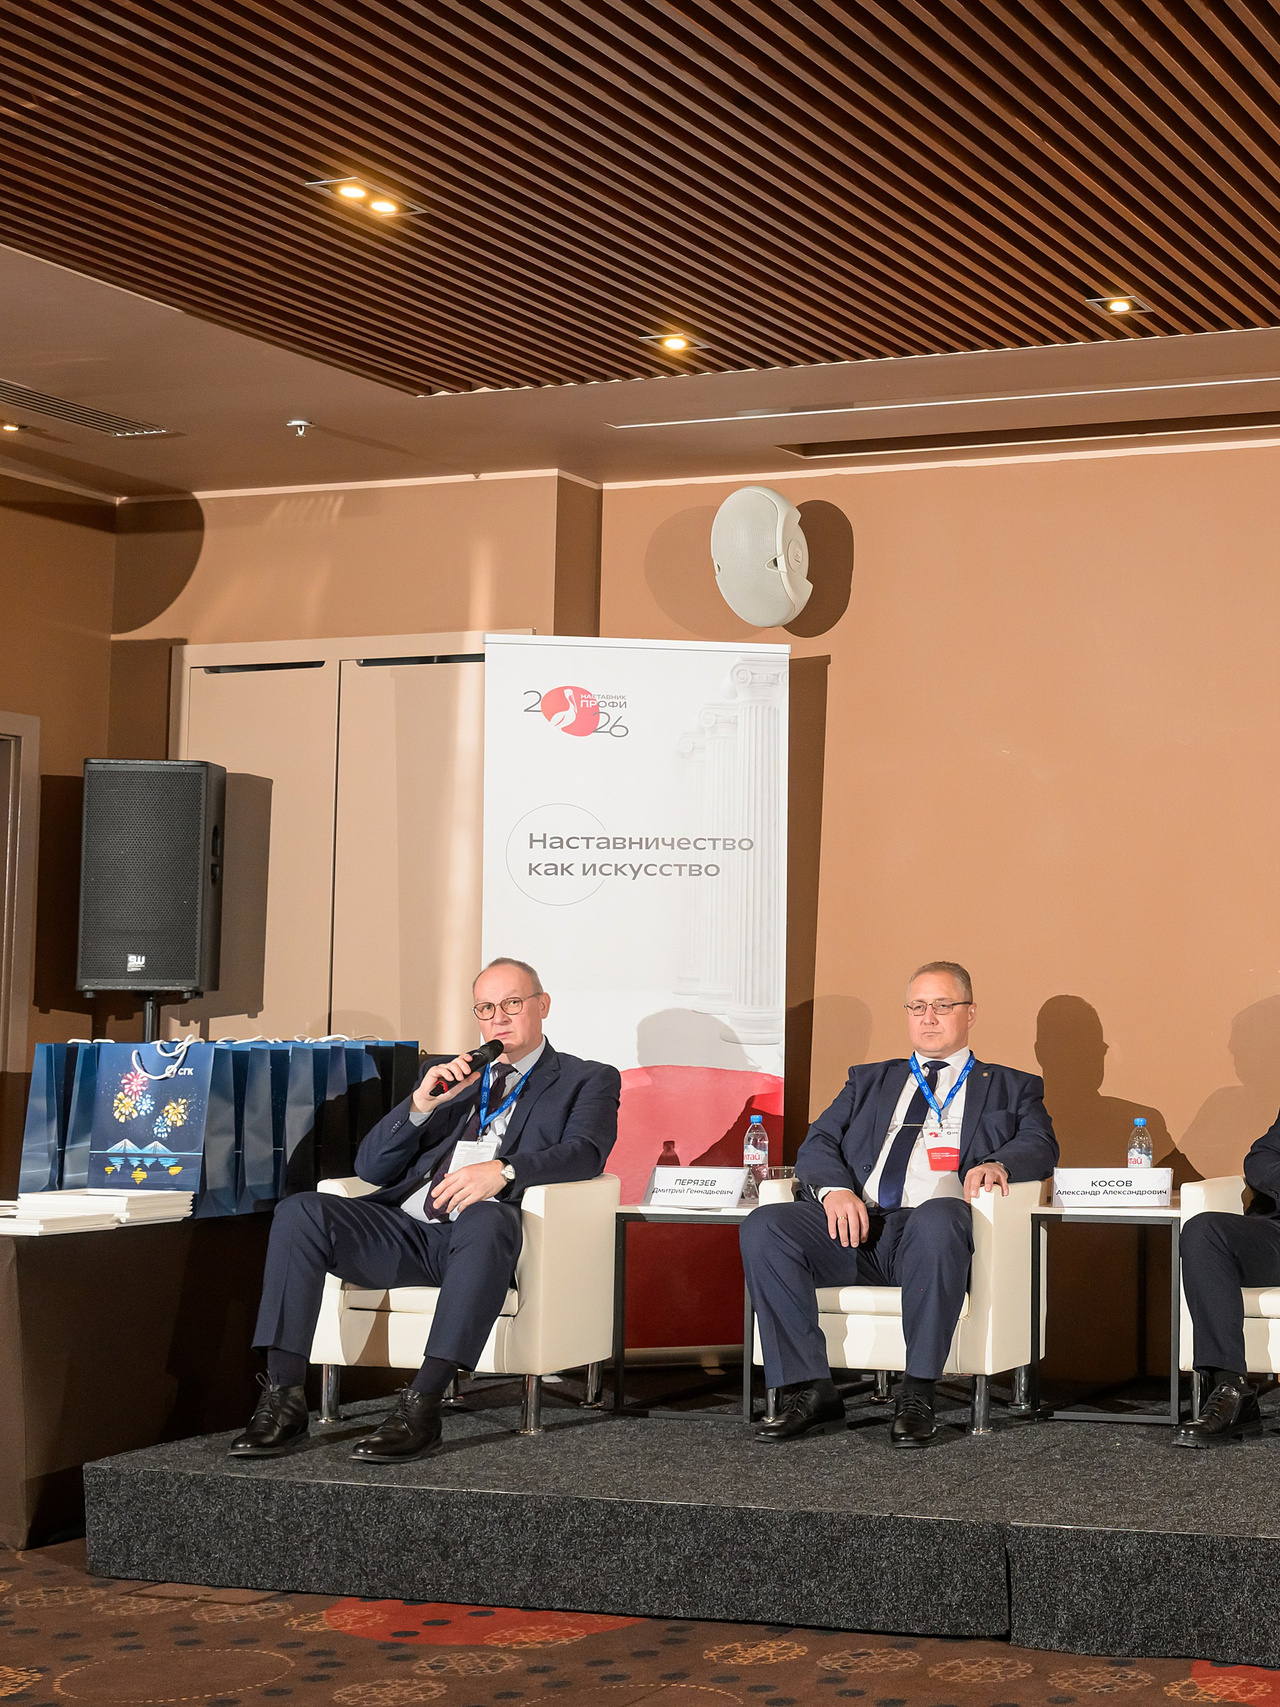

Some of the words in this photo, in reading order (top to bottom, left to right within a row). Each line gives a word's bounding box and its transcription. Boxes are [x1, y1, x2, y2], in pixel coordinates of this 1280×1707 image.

[580, 700, 627, 708] ПРОФИ
[528, 832, 754, 851] Наставничество
[528, 862, 575, 877] как
[582, 862, 721, 880] искусство
[178, 1067, 194, 1076] СГК
[674, 1178, 717, 1187] ПЕРЯЗЕВ
[1091, 1180, 1133, 1188] КОСОВ
[652, 1187, 684, 1196] Дмитрий
[1056, 1189, 1101, 1197] Александр
